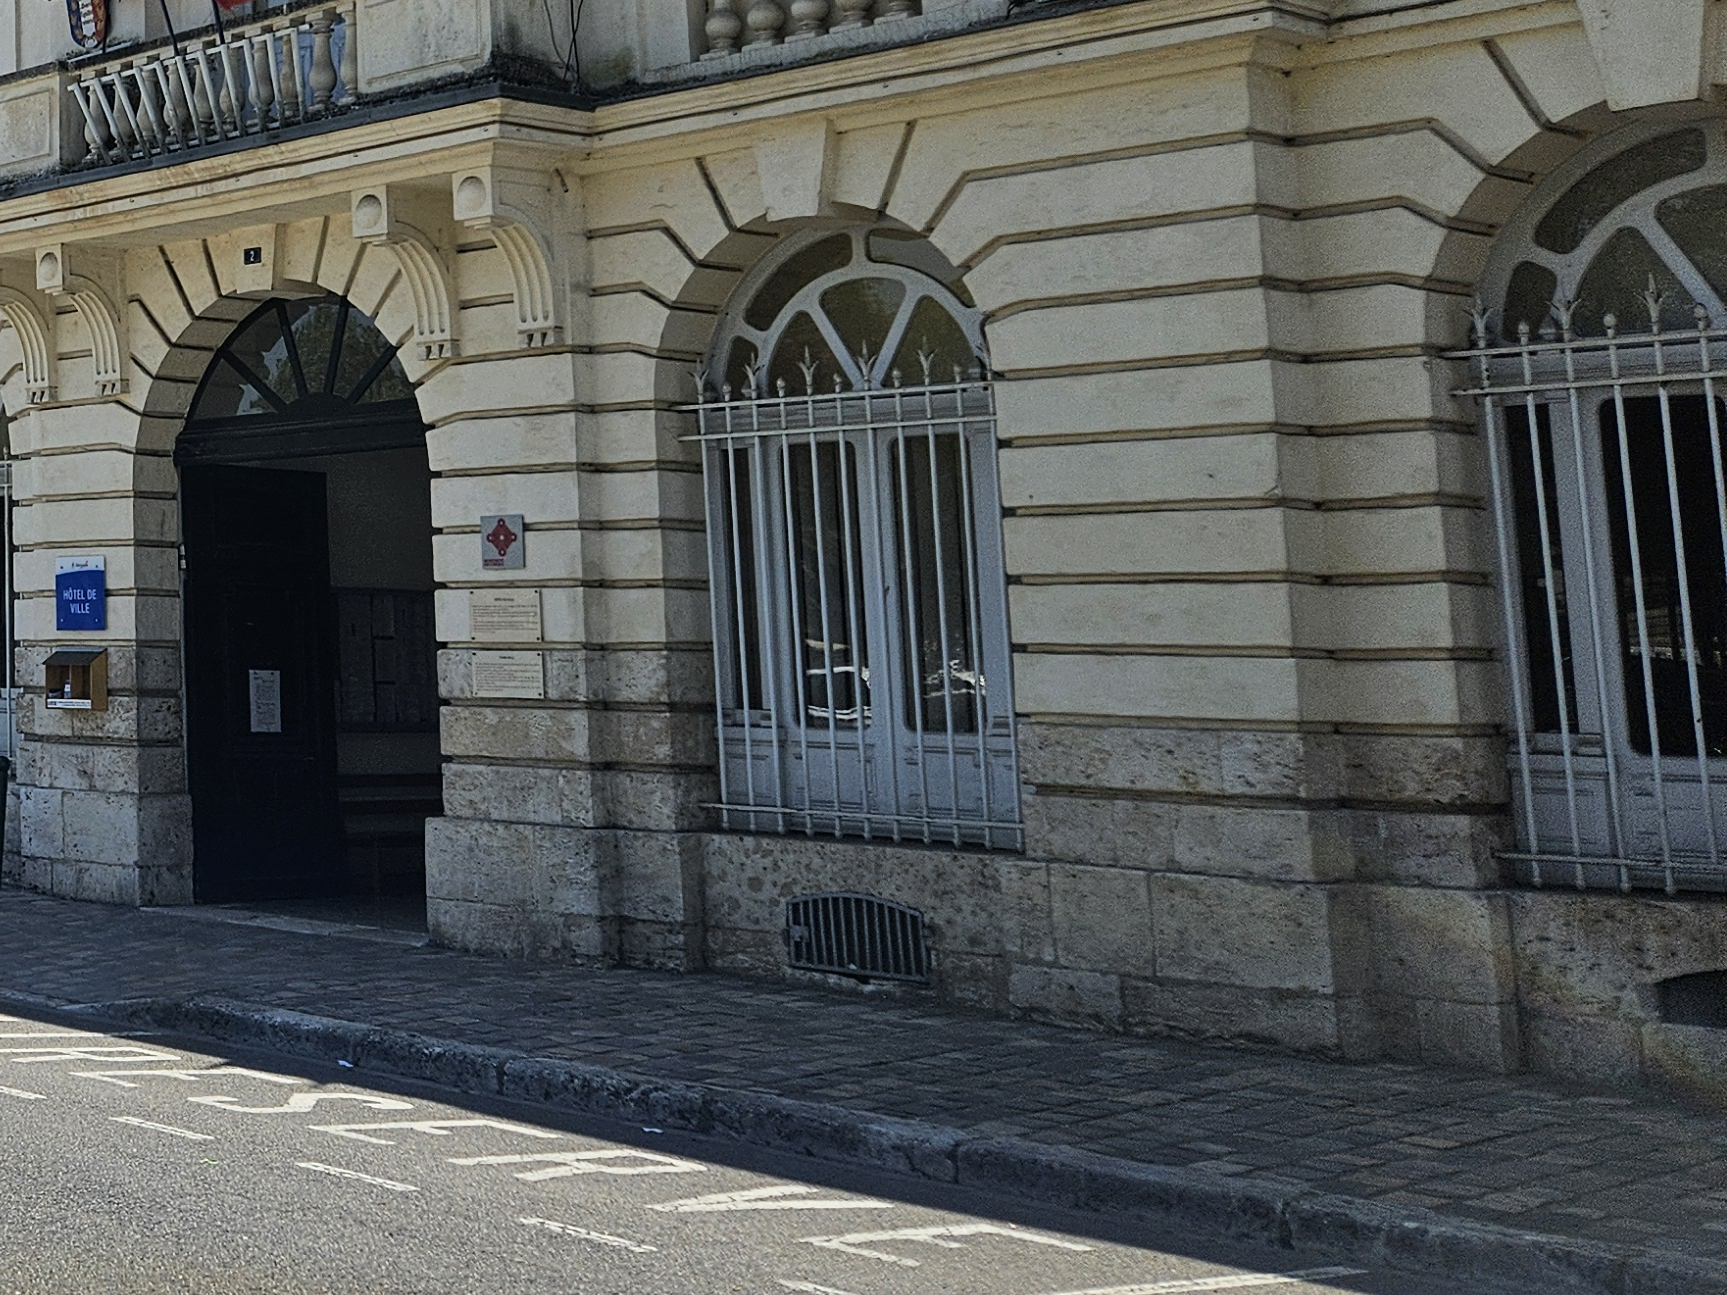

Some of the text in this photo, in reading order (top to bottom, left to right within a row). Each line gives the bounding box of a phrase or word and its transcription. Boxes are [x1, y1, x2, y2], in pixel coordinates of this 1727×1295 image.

[249, 250, 255, 262] 2
[62, 588, 97, 600] HÔTEL DE
[69, 602, 90, 614] VILLE
